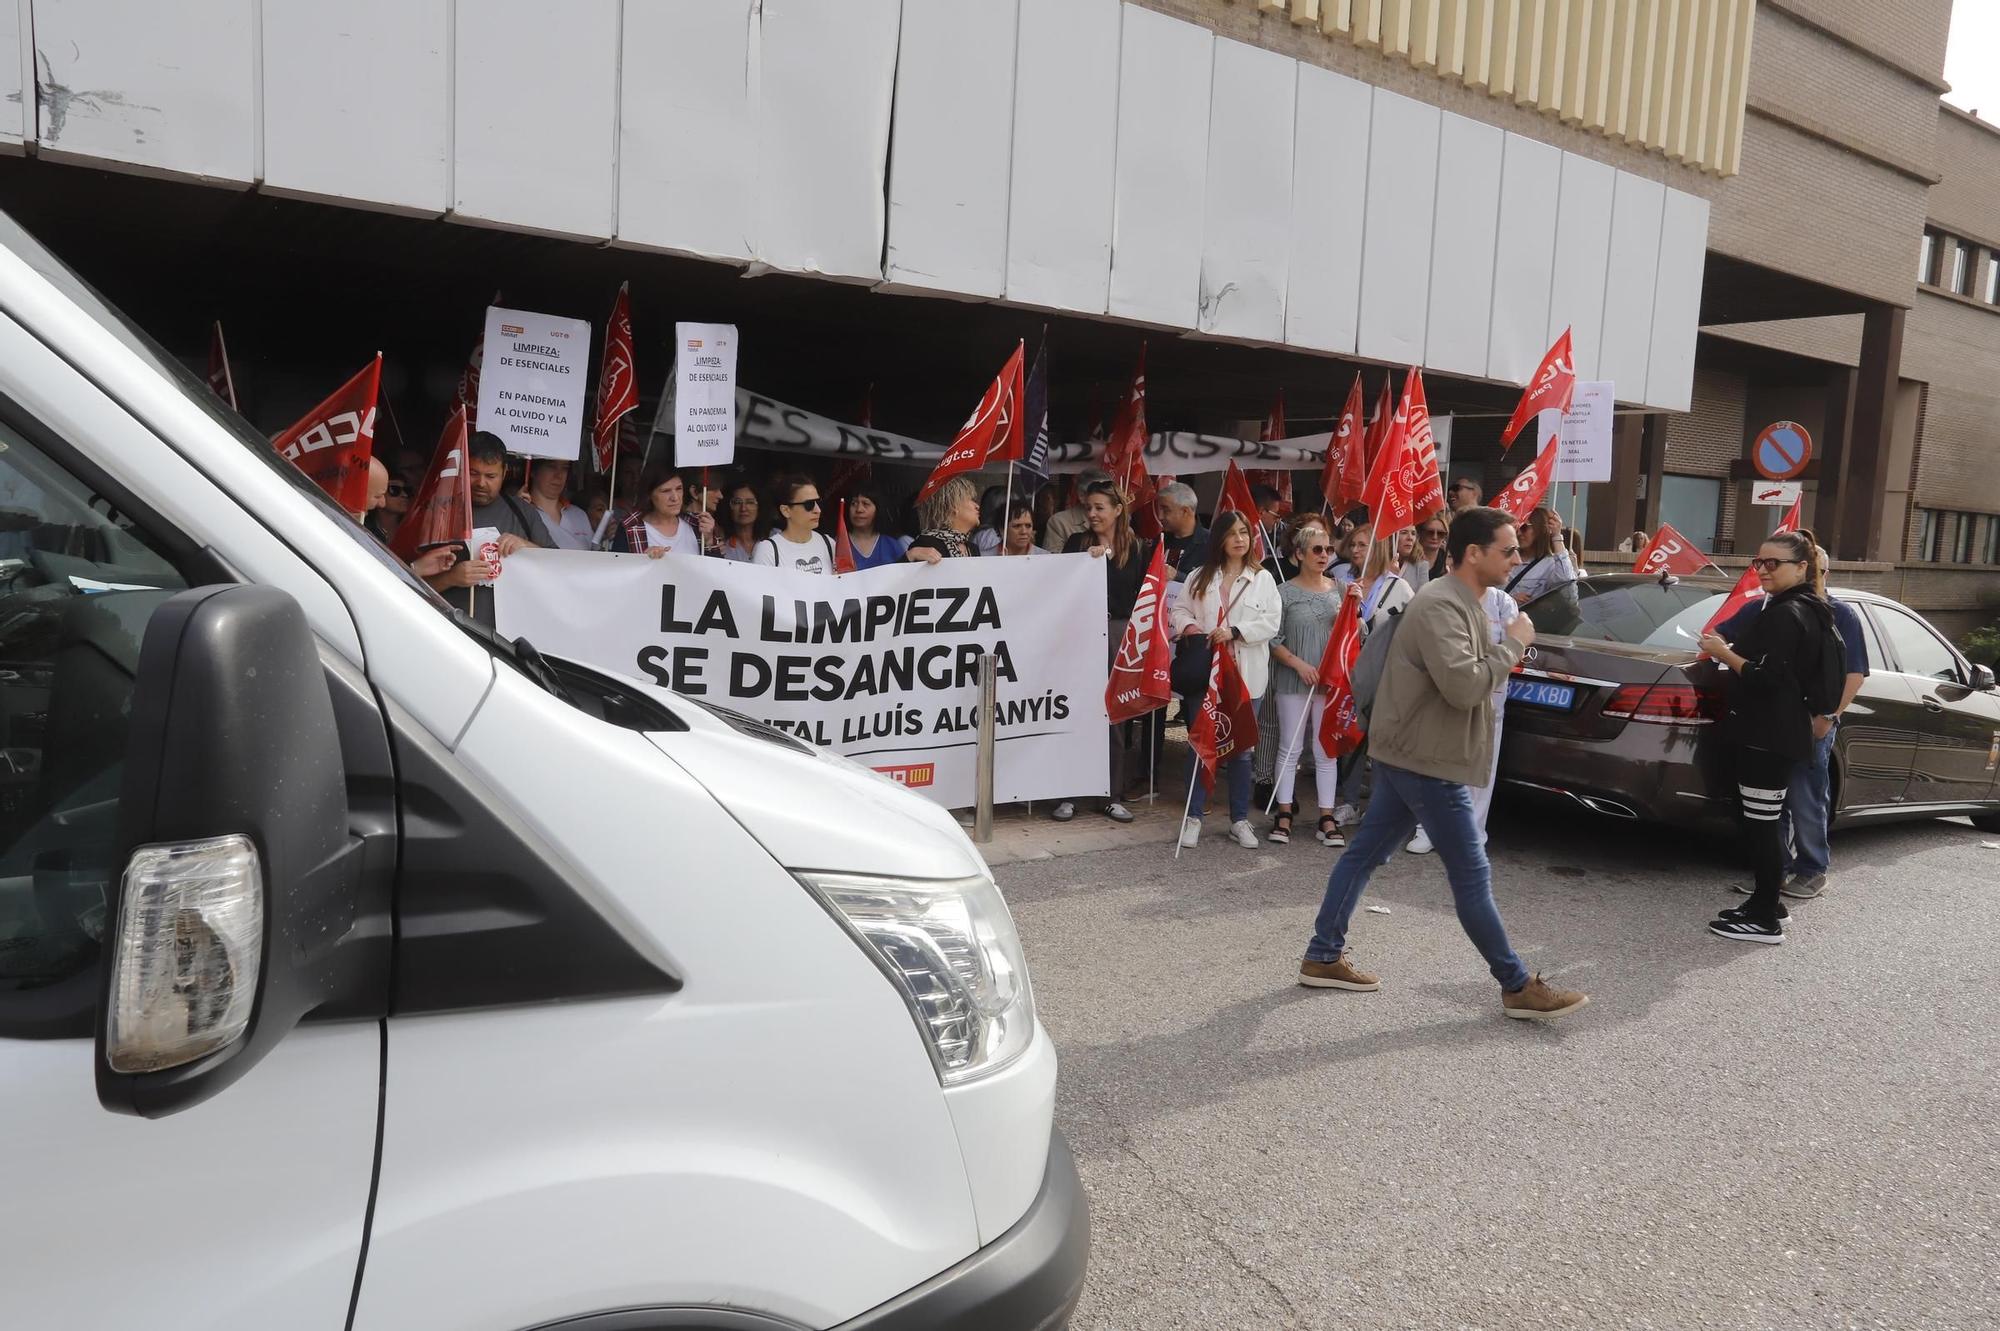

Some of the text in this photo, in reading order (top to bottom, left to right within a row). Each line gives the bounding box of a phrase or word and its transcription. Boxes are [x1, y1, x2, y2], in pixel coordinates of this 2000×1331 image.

[513, 342, 560, 357] LIMPIEZA:
[500, 357, 570, 374] DE ESENCIALES
[689, 373, 728, 382] DE ESENCIALES
[499, 391, 566, 408] EN PANDEMIA
[495, 407, 567, 425] AL OLVIDO Y LA
[689, 407, 727, 416] EN PANDEMIA
[510, 424, 550, 438] MISERIA
[687, 424, 695, 433] AL
[696, 424, 716, 433] OLVIDO
[697, 438, 719, 447] MISERIA
[661, 584, 1001, 644] LA LIMPIEZA
[636, 640, 1018, 701] SE DESANGRA
[1537, 685, 1570, 705] KBD
[842, 702, 923, 744] LLUÍS
